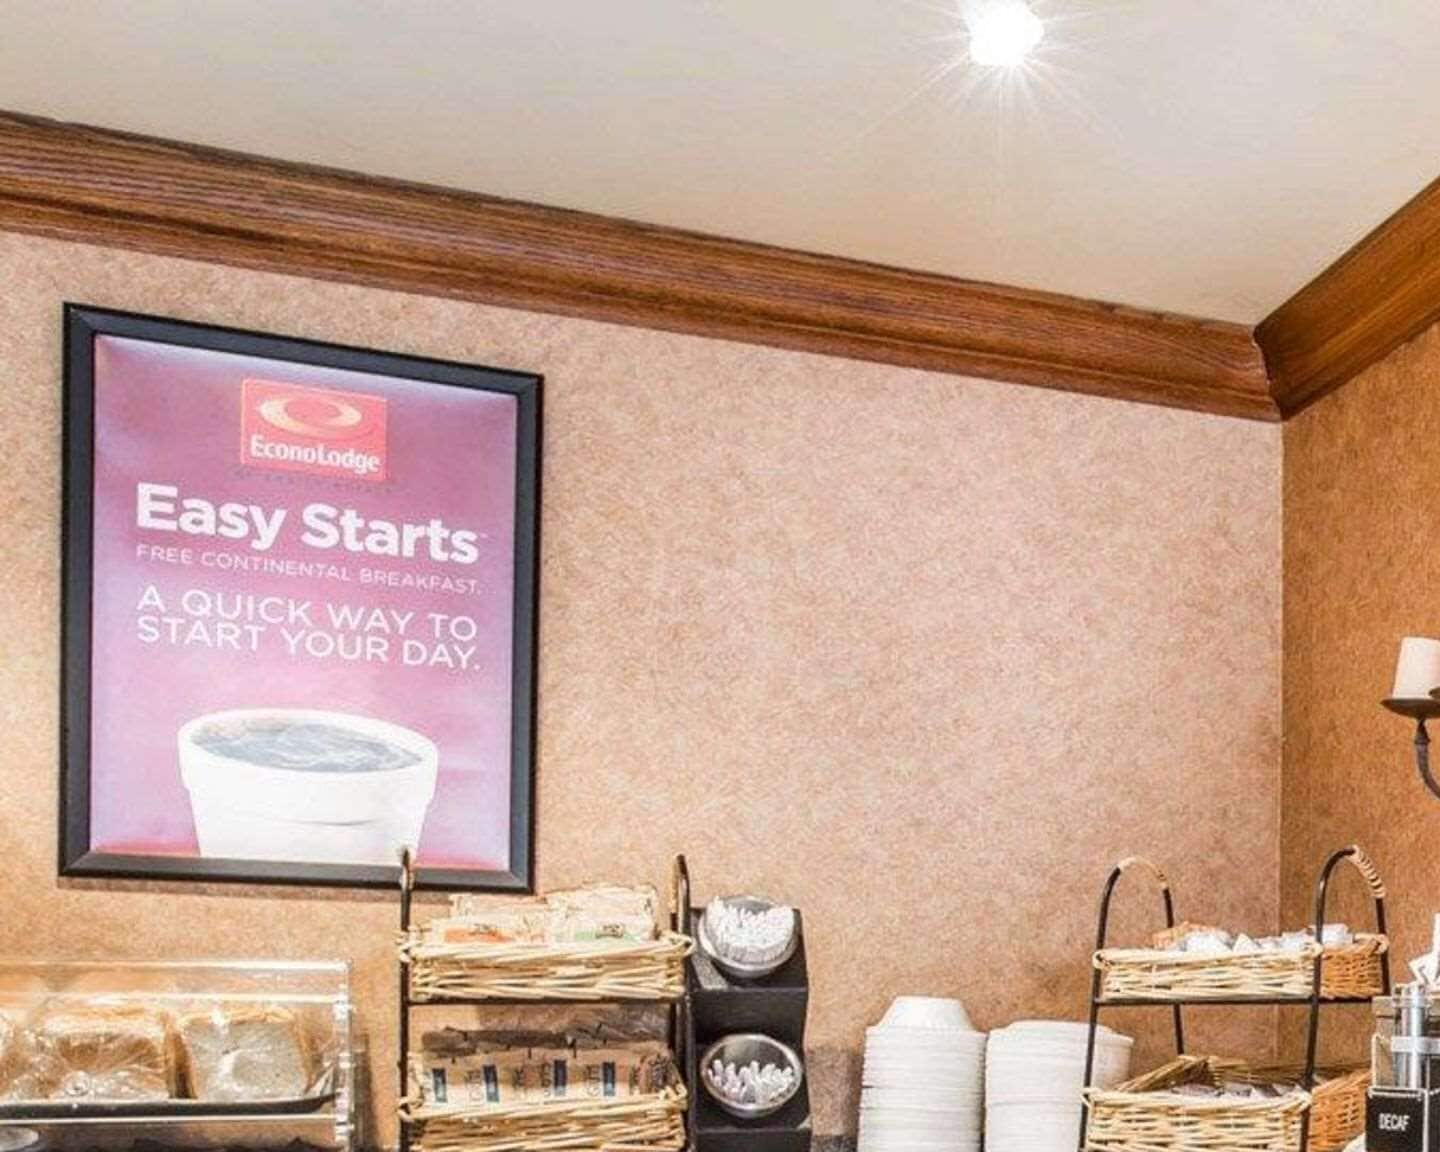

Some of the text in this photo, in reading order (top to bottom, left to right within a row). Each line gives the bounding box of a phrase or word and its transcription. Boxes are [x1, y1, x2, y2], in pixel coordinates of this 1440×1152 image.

[250, 433, 381, 475] EconoLodge
[136, 481, 480, 564] Easy Starts
[136, 543, 193, 566] FREE
[200, 551, 351, 582] CONTINENTAL
[136, 584, 478, 642] A QUICK WAY TO
[136, 615, 481, 672] START YOUR DAY.
[1378, 1112, 1410, 1131] DECAF
